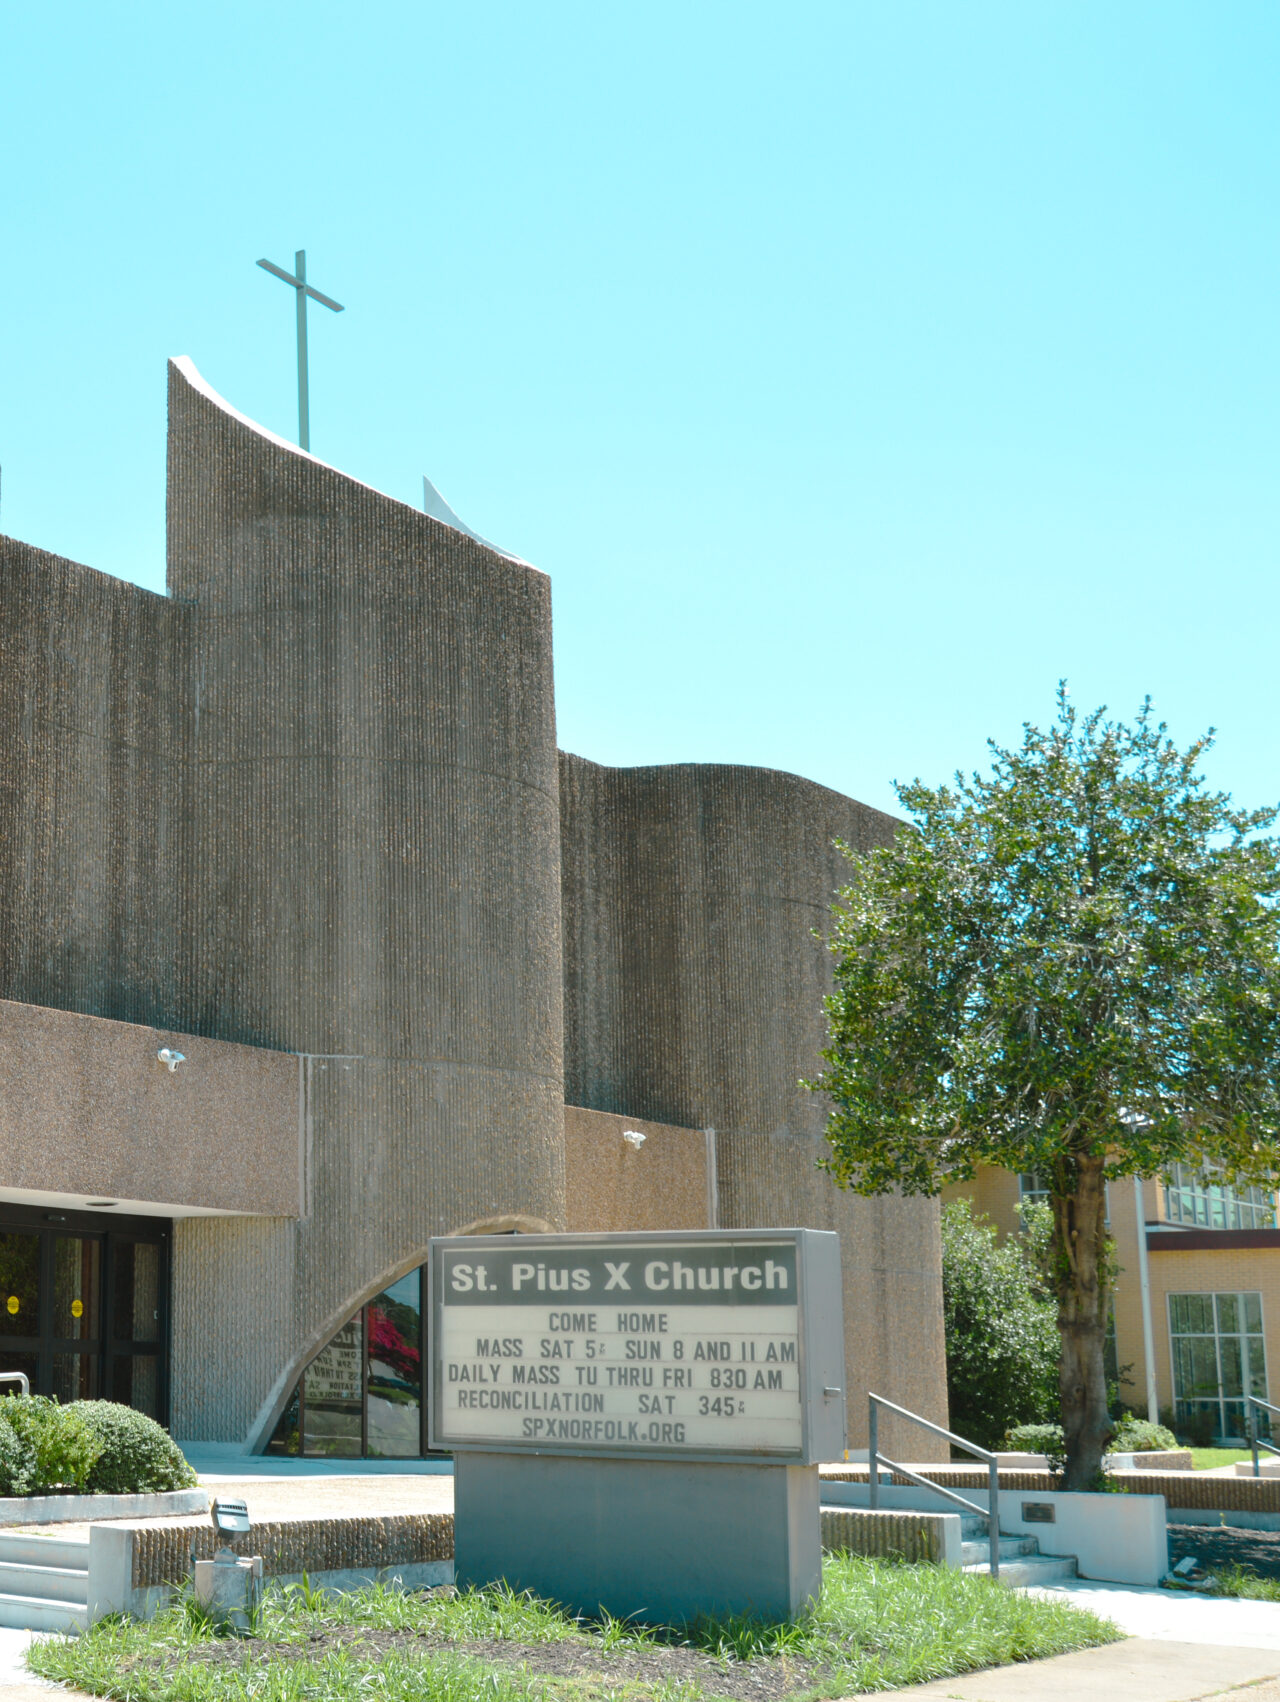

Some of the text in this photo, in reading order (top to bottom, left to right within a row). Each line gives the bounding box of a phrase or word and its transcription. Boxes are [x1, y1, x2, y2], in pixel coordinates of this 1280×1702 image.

[451, 1259, 788, 1292] St. Pius X Church
[549, 1312, 668, 1333] COME HOME
[476, 1338, 523, 1358] MASS
[540, 1339, 574, 1359] SAT
[625, 1340, 661, 1360] SUN
[673, 1340, 684, 1360] 8
[693, 1341, 731, 1361] AND
[766, 1342, 795, 1362] AM
[448, 1363, 783, 1389] DAILY MASS TU THRU FRI 830 AM
[458, 1389, 604, 1412] RECONCILIATION
[638, 1394, 676, 1415] SAT
[522, 1417, 685, 1442] SPXNORFOLK.ORG
